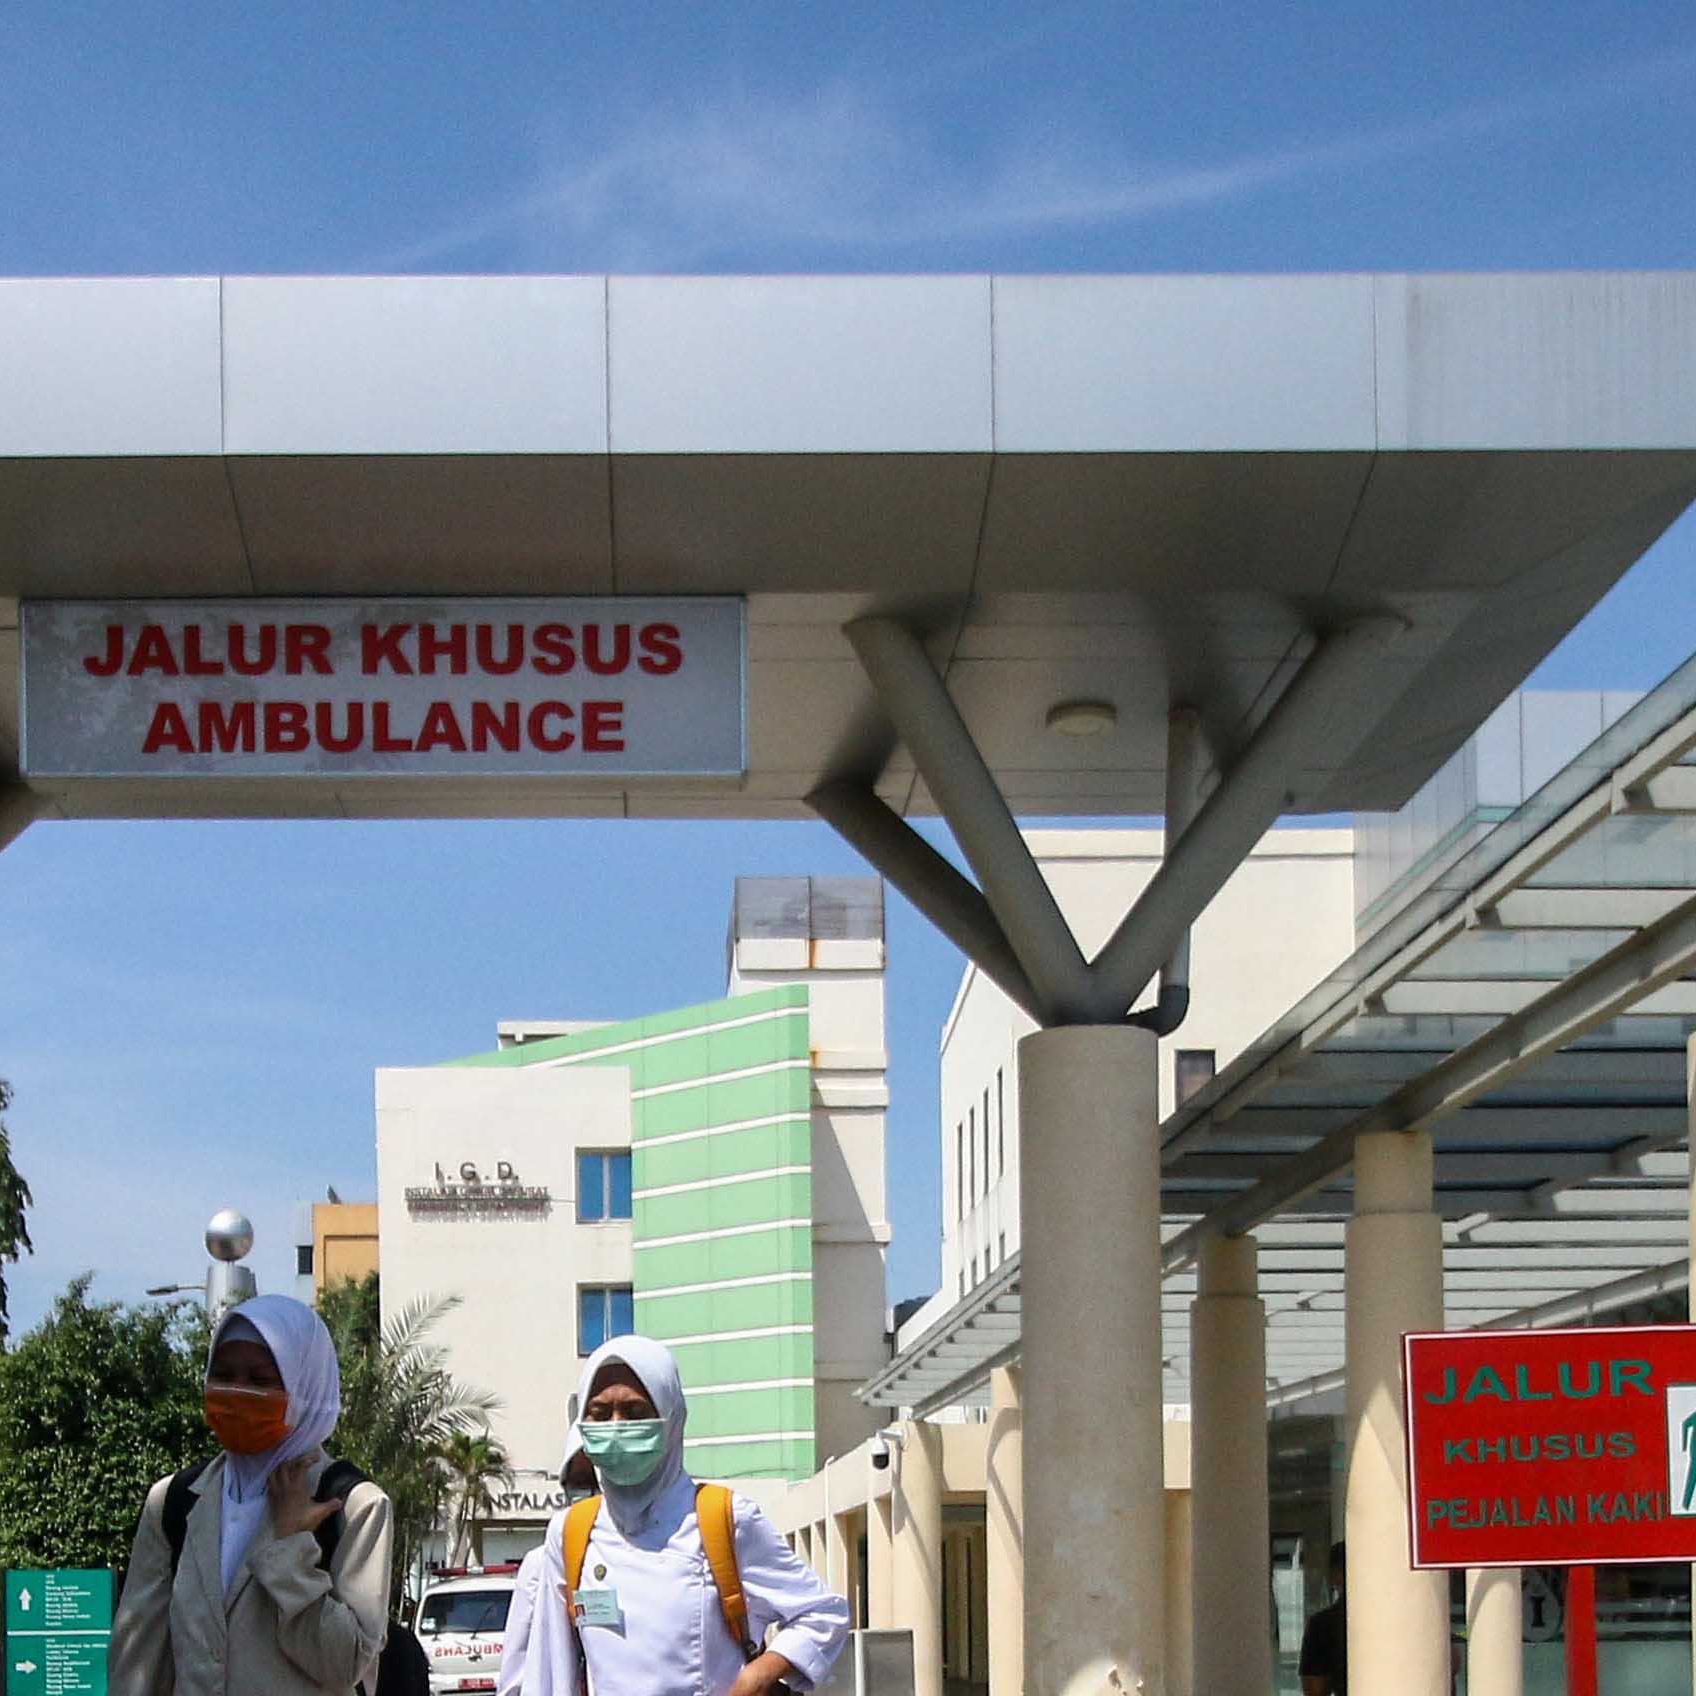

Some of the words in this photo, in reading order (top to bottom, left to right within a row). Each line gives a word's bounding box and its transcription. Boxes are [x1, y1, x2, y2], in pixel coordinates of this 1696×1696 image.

[83, 623, 333, 677] JALUR
[360, 622, 684, 677] KHUSUS
[141, 701, 626, 755] AMBULANCE
[1423, 1359, 1656, 1405] JALUR
[1443, 1431, 1637, 1465] KHUSUS
[488, 1491, 567, 1511] NSTALAS
[1427, 1494, 1577, 1530] PEJALAN
[1587, 1490, 1665, 1525] KAKI
